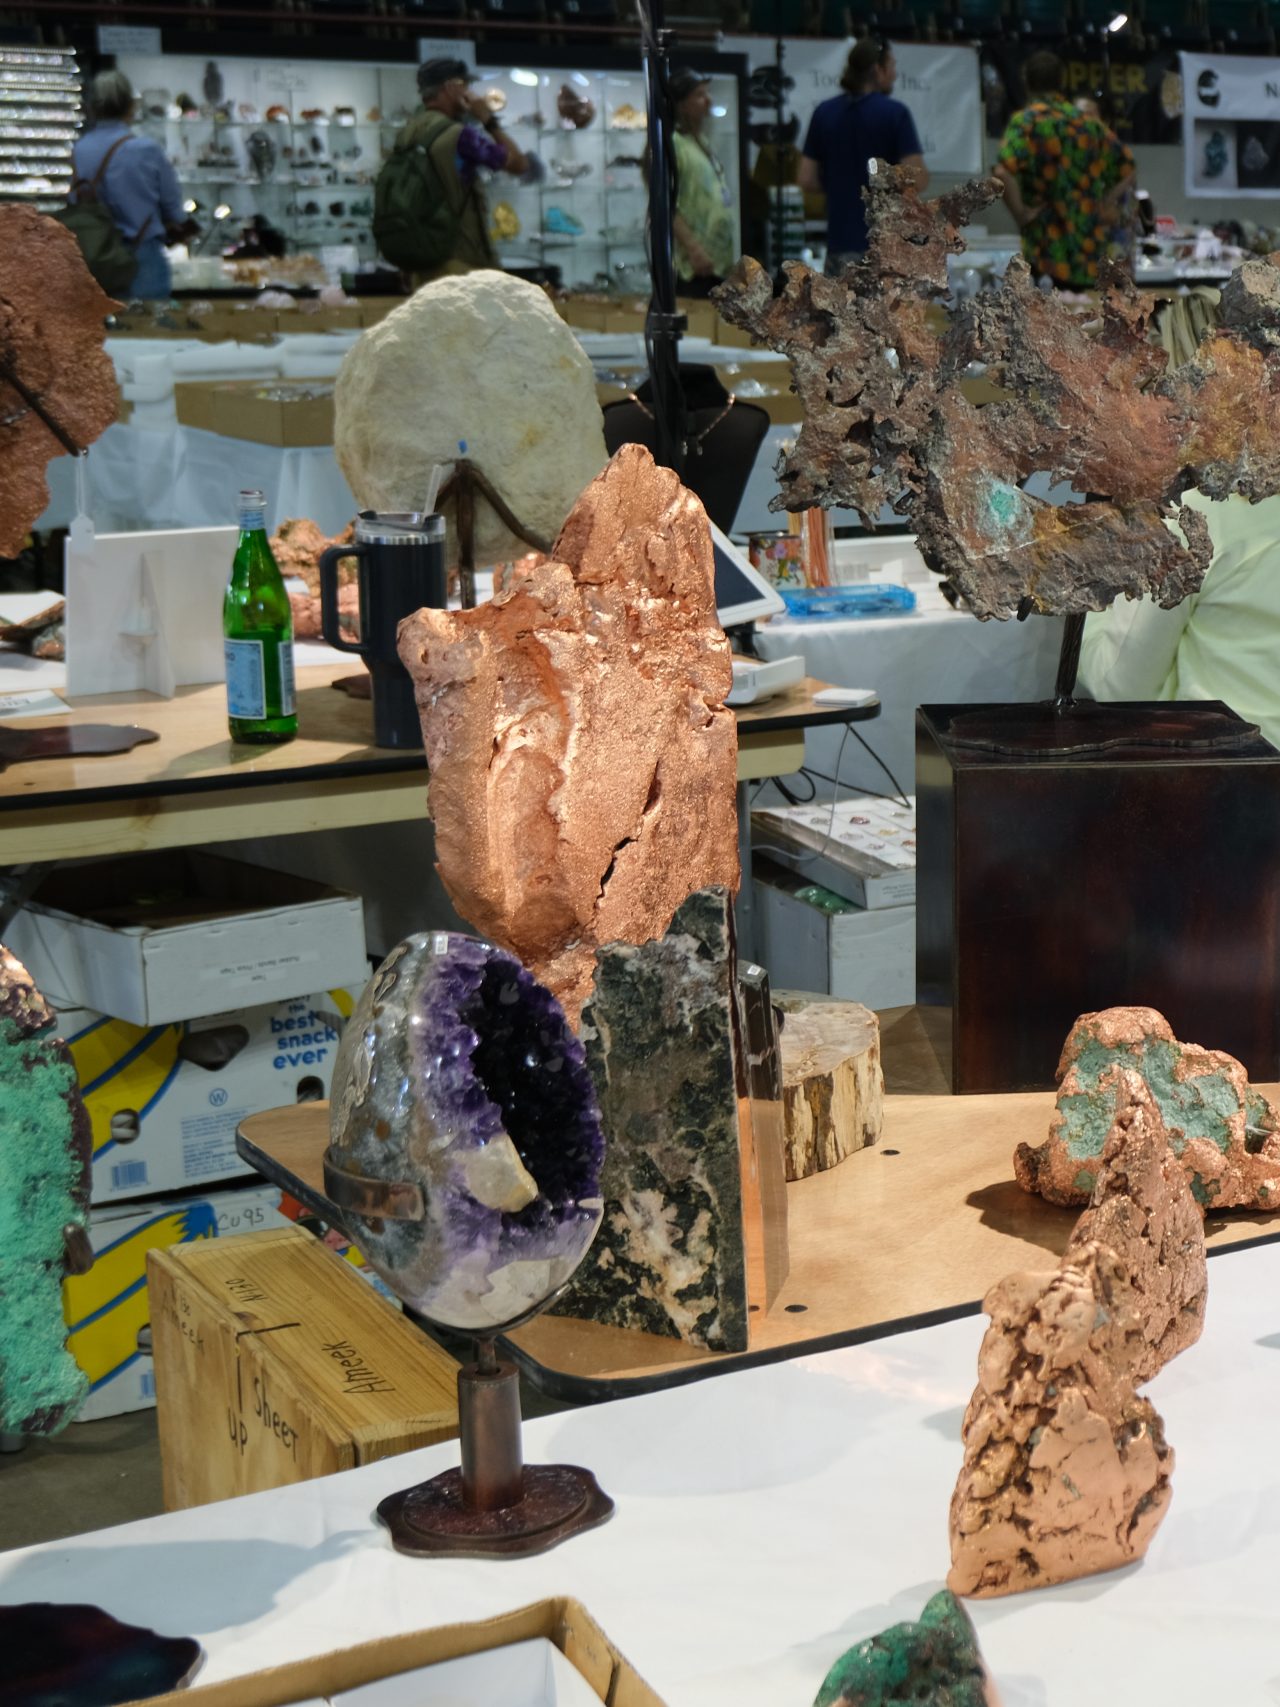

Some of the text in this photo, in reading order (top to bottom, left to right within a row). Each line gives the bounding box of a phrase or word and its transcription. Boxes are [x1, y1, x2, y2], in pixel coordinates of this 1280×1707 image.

[1062, 60, 1148, 94] PPER
[270, 1010, 319, 1033] best
[277, 1026, 337, 1050] snack
[273, 1048, 329, 1070] ever
